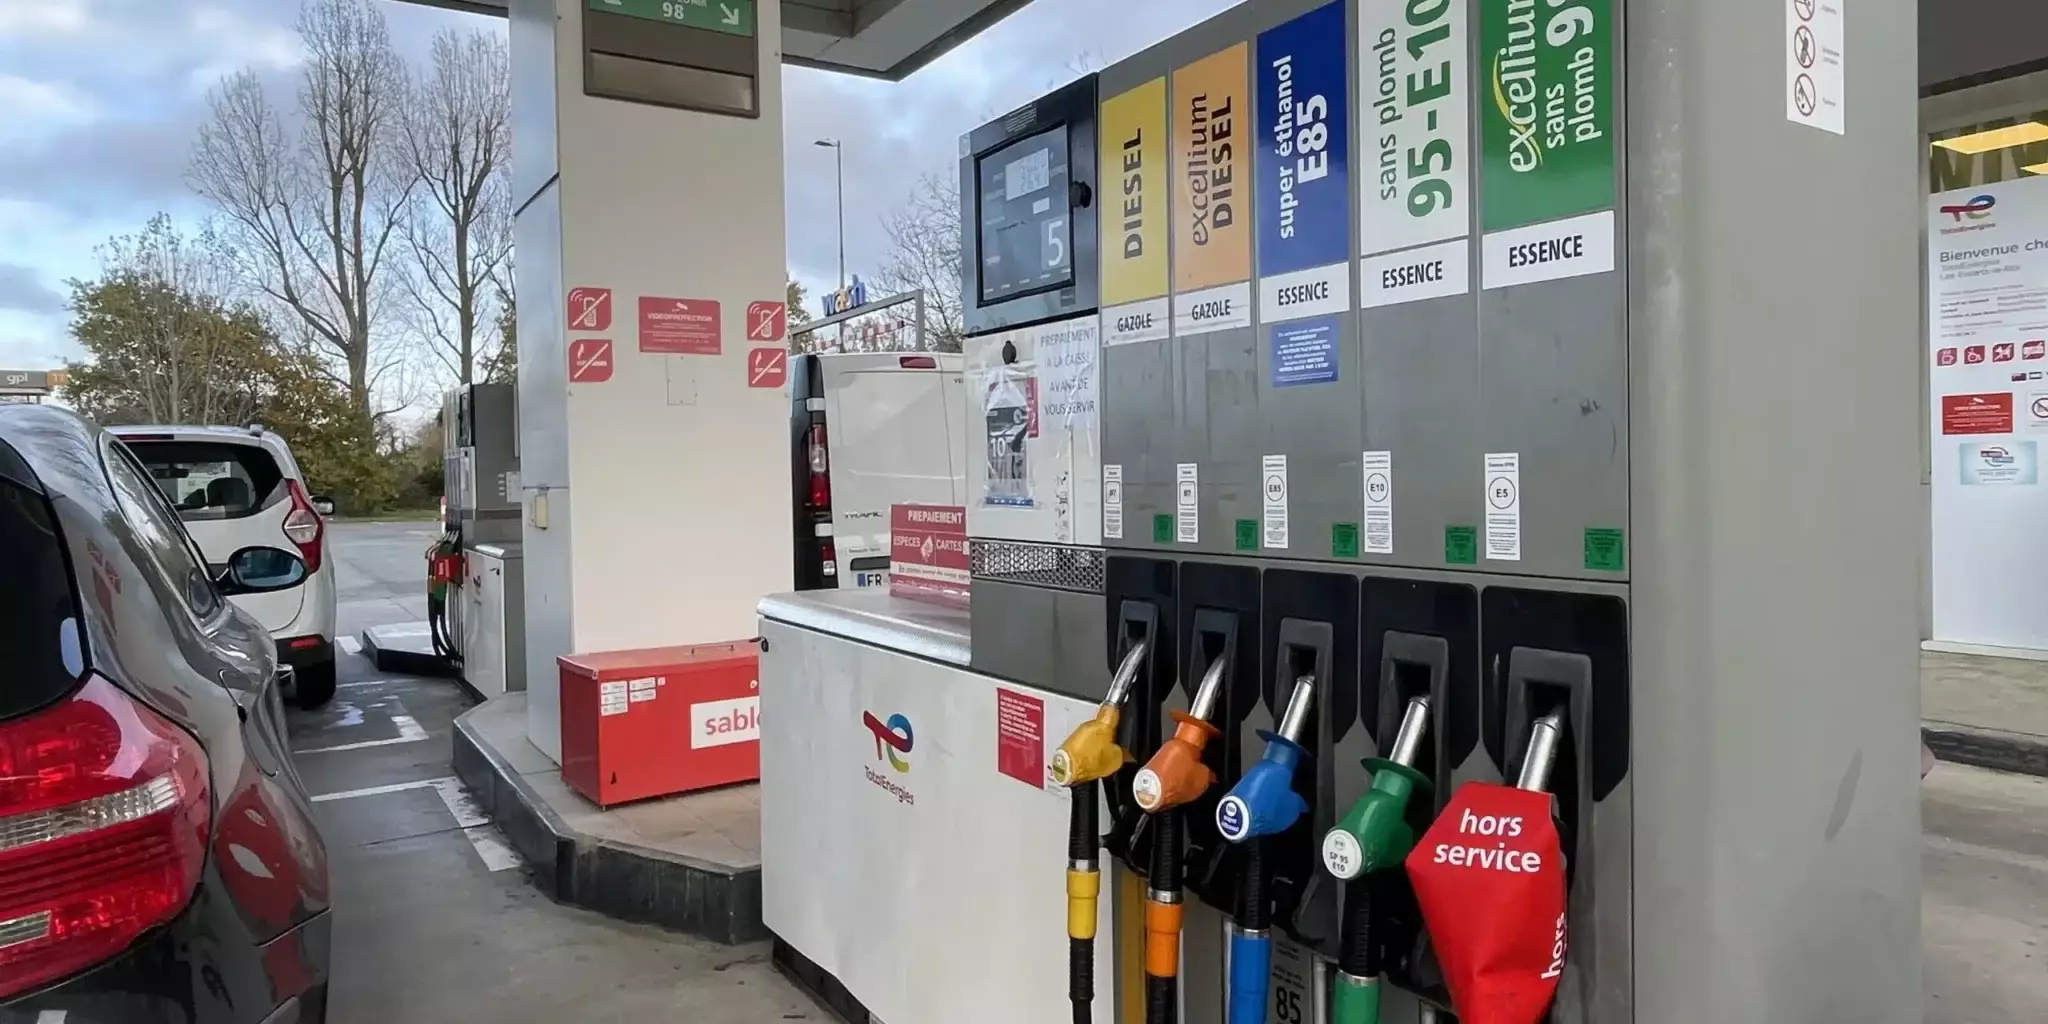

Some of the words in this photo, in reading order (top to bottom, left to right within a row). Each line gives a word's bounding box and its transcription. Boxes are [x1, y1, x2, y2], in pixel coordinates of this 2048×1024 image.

[663, 3, 684, 20] 98
[1546, 0, 1594, 47] 9
[1373, 28, 1402, 125] plomb
[1567, 46, 1602, 142] plomb
[1273, 55, 1294, 157] éthanol
[1546, 83, 1565, 148] sans
[1297, 94, 1328, 184] E85
[1188, 93, 1208, 246] excellium
[1211, 95, 1233, 229] DIESEL
[1380, 133, 1397, 200] sans
[1123, 127, 1142, 259] DIESEL
[1279, 166, 1298, 239] super
[1048, 219, 1064, 267] 5
[1509, 235, 1583, 268] ESSENCE
[1940, 244, 2019, 263] Bienvenue
[1278, 281, 1328, 306] ESSENCE
[1382, 260, 1443, 289] ESSENCE
[821, 273, 866, 317] wash
[1191, 299, 1231, 321] GAZOLE
[1117, 312, 1152, 333] GAZOLE
[6, 372, 28, 385] gpl
[1044, 403, 1066, 416] VOUS
[990, 437, 1006, 458] 10
[1268, 484, 1282, 493] E85
[1370, 483, 1385, 492] E10
[1496, 488, 1508, 498] E5
[863, 765, 914, 806] TotalEnergies
[1459, 808, 1523, 837] hors
[1433, 842, 1541, 873] service
[1540, 912, 1567, 980] hors
[1276, 985, 1302, 1024] 85
